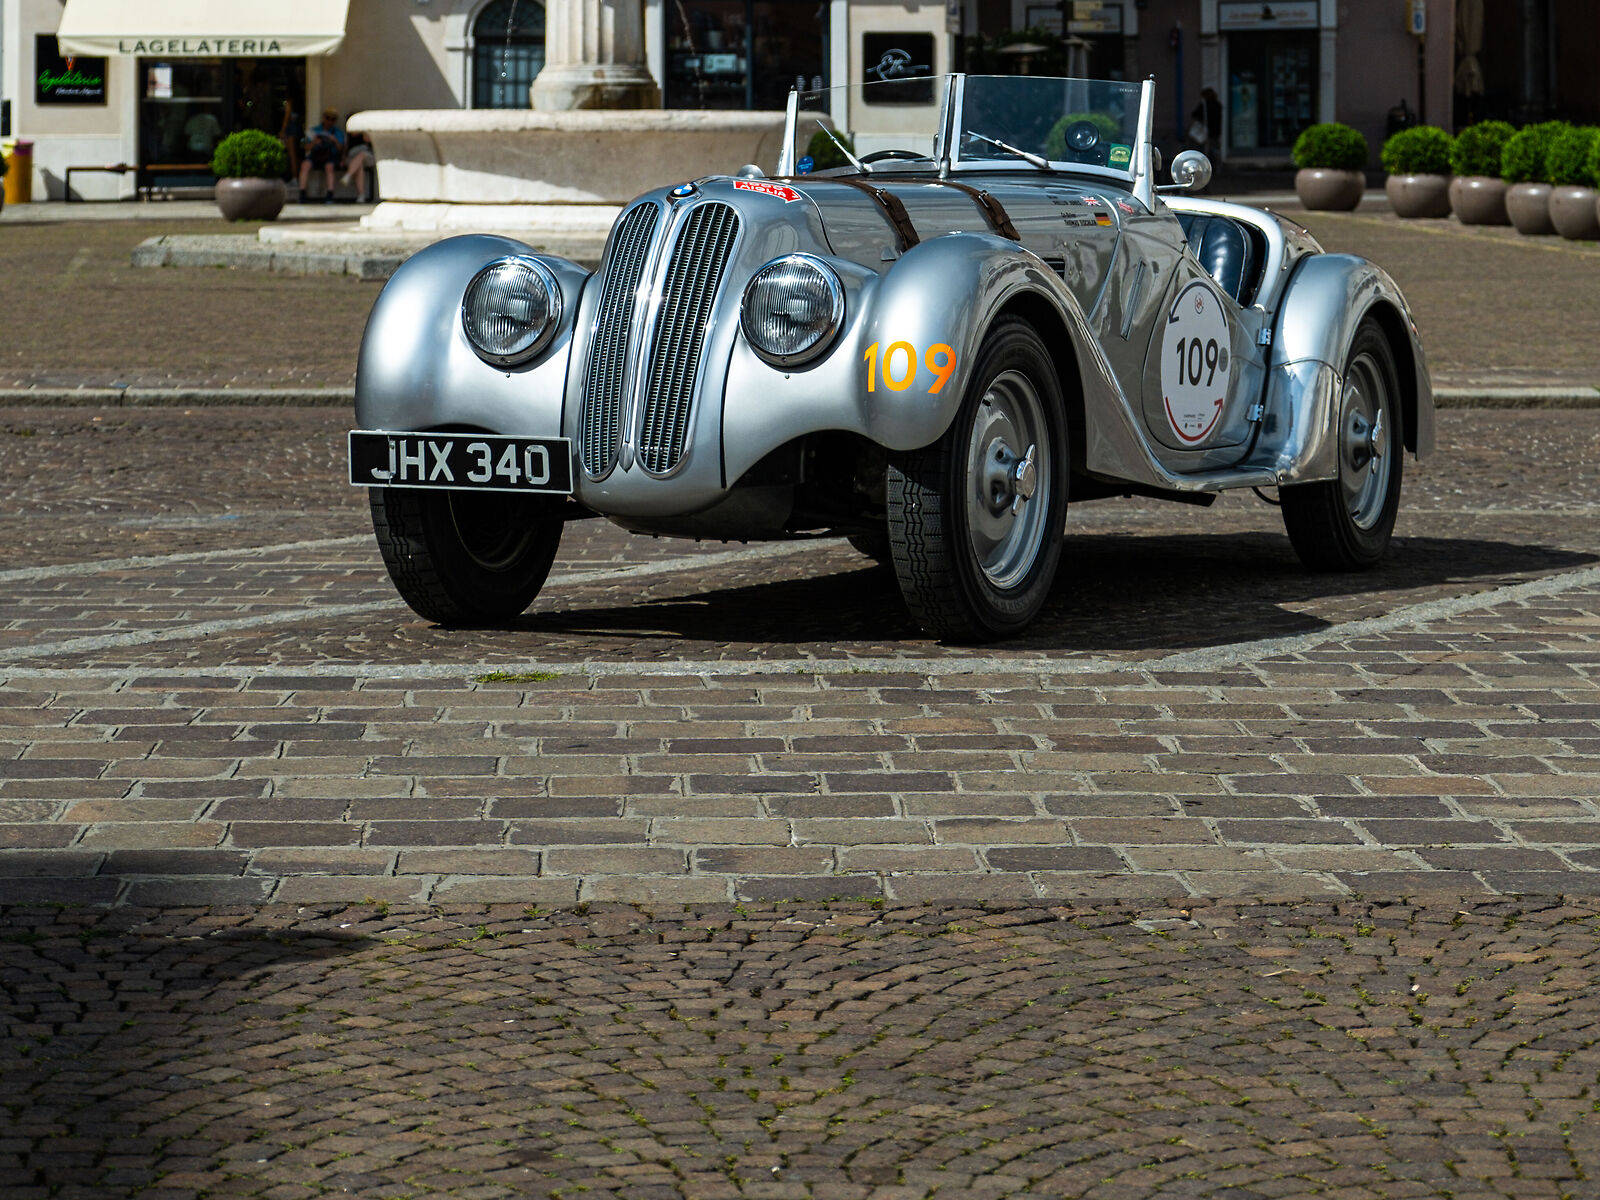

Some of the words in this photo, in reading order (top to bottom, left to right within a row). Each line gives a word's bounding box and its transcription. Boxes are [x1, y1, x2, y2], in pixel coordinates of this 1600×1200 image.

[118, 39, 281, 54] LAGELATERIA
[863, 340, 957, 394] 109
[1176, 336, 1219, 387] 109
[371, 439, 455, 482] JHX
[466, 442, 551, 485] 340
